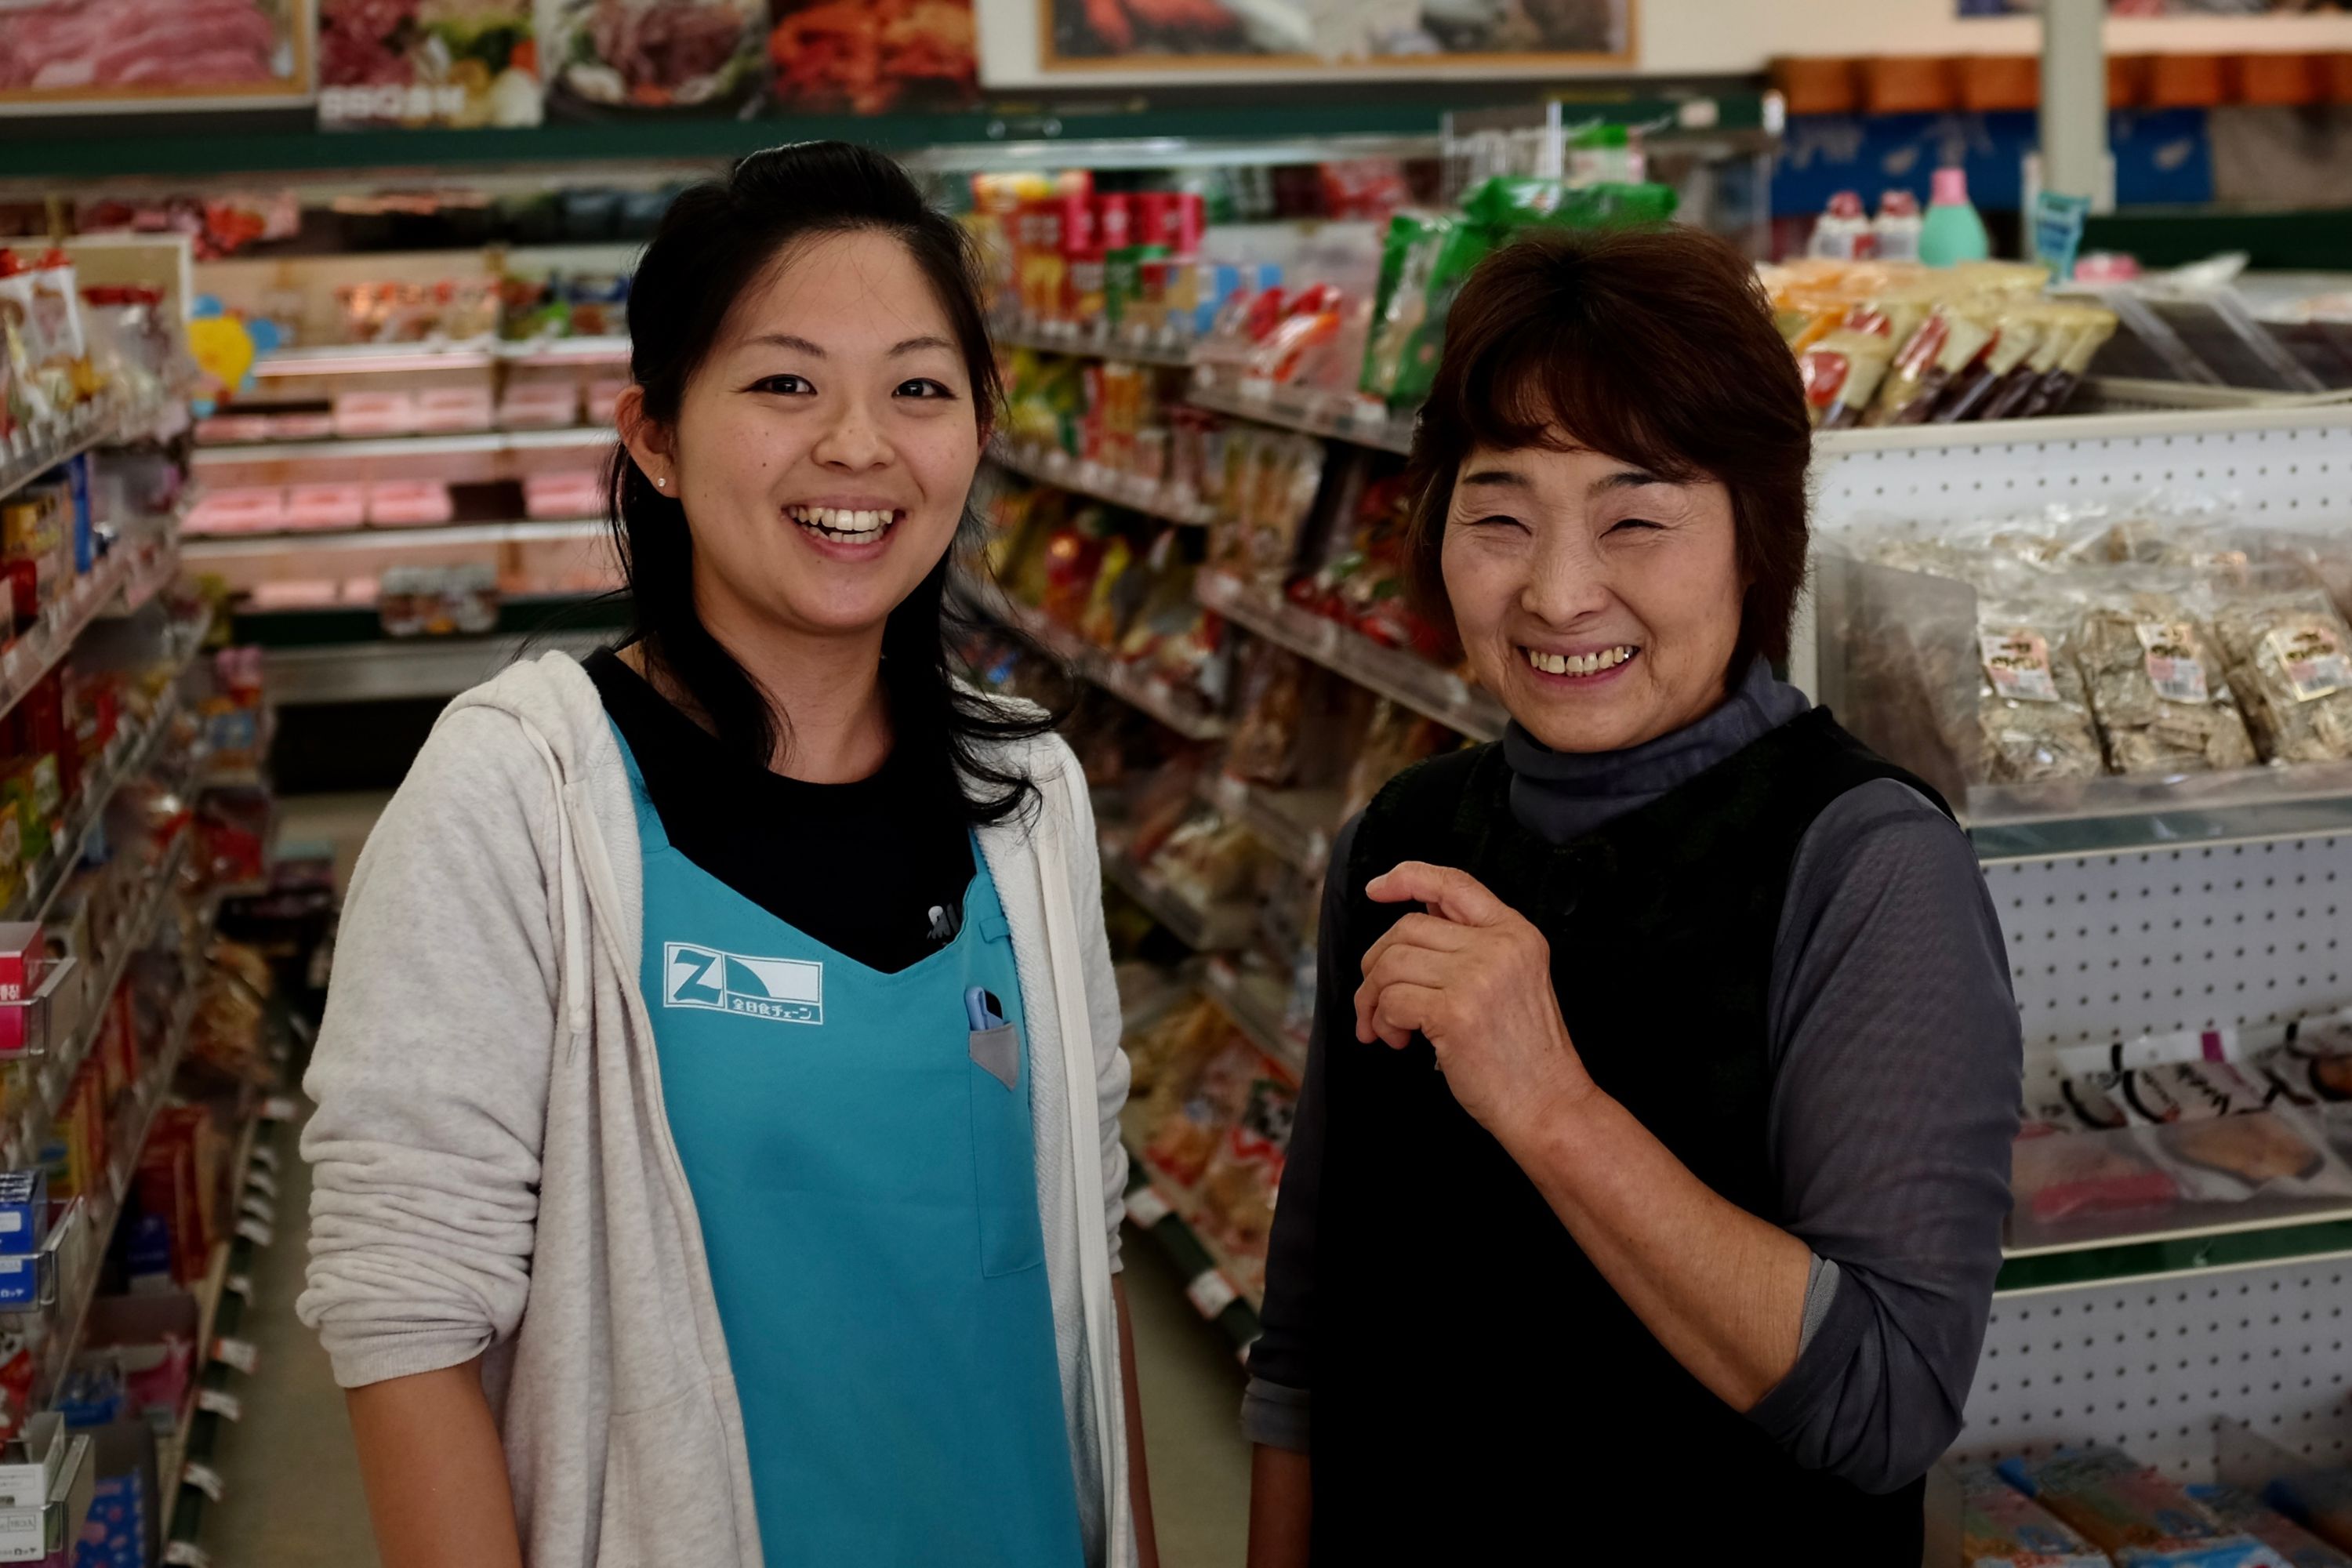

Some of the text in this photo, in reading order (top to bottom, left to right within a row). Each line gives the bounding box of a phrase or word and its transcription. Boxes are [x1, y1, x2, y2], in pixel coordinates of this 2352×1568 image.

[673, 949, 722, 1004] Z
[732, 998, 811, 1020] 全日食チェーン
